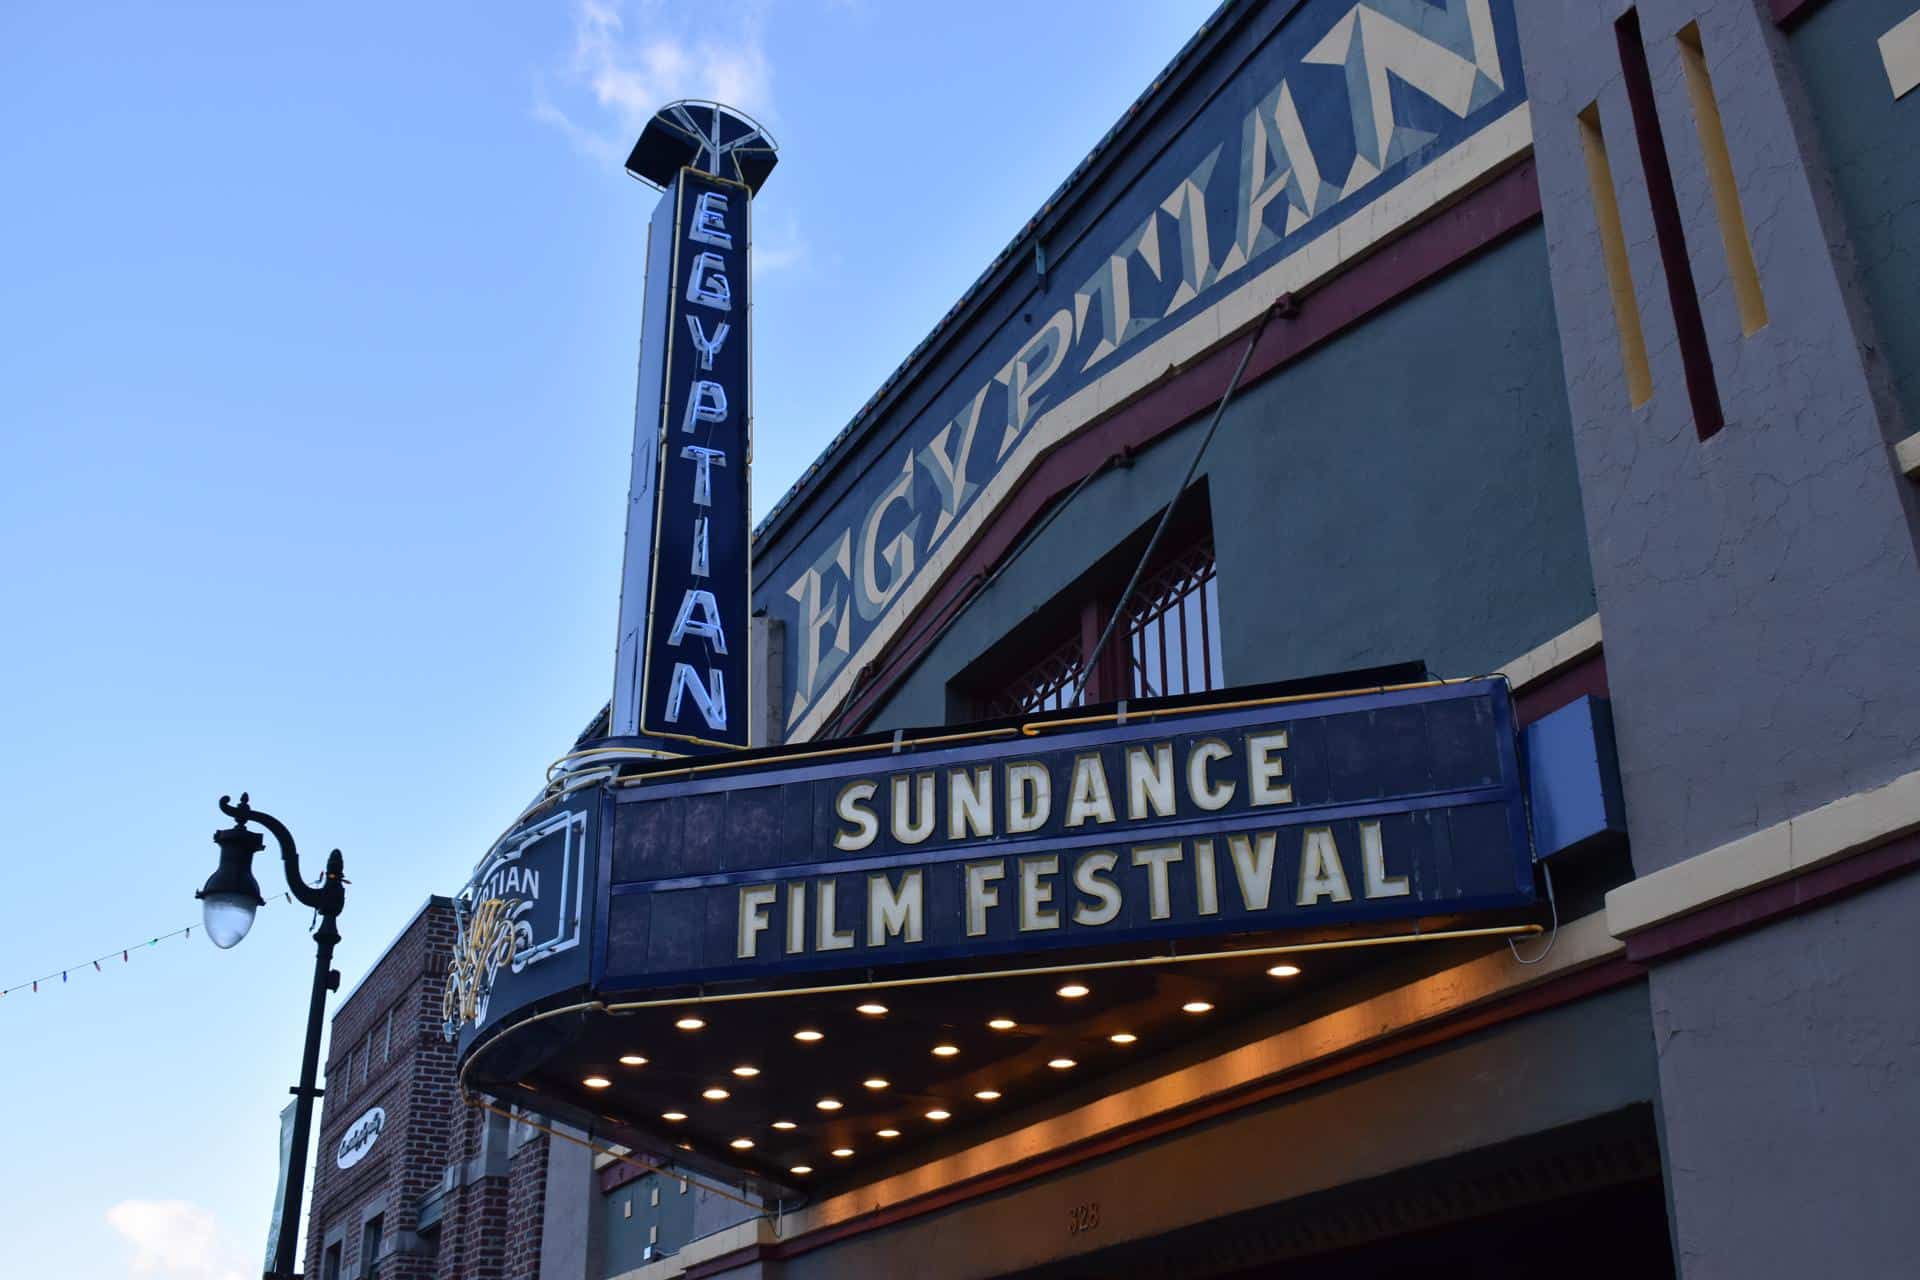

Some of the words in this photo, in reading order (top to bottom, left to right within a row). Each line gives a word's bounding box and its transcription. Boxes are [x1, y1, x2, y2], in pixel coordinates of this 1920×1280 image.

[663, 191, 732, 731] EGYPTIAN
[784, 0, 1504, 732] EGYPTIAN
[736, 868, 924, 958] FILM
[965, 820, 1411, 937] FESTIVAL
[834, 730, 1293, 851] SUNDANCE
